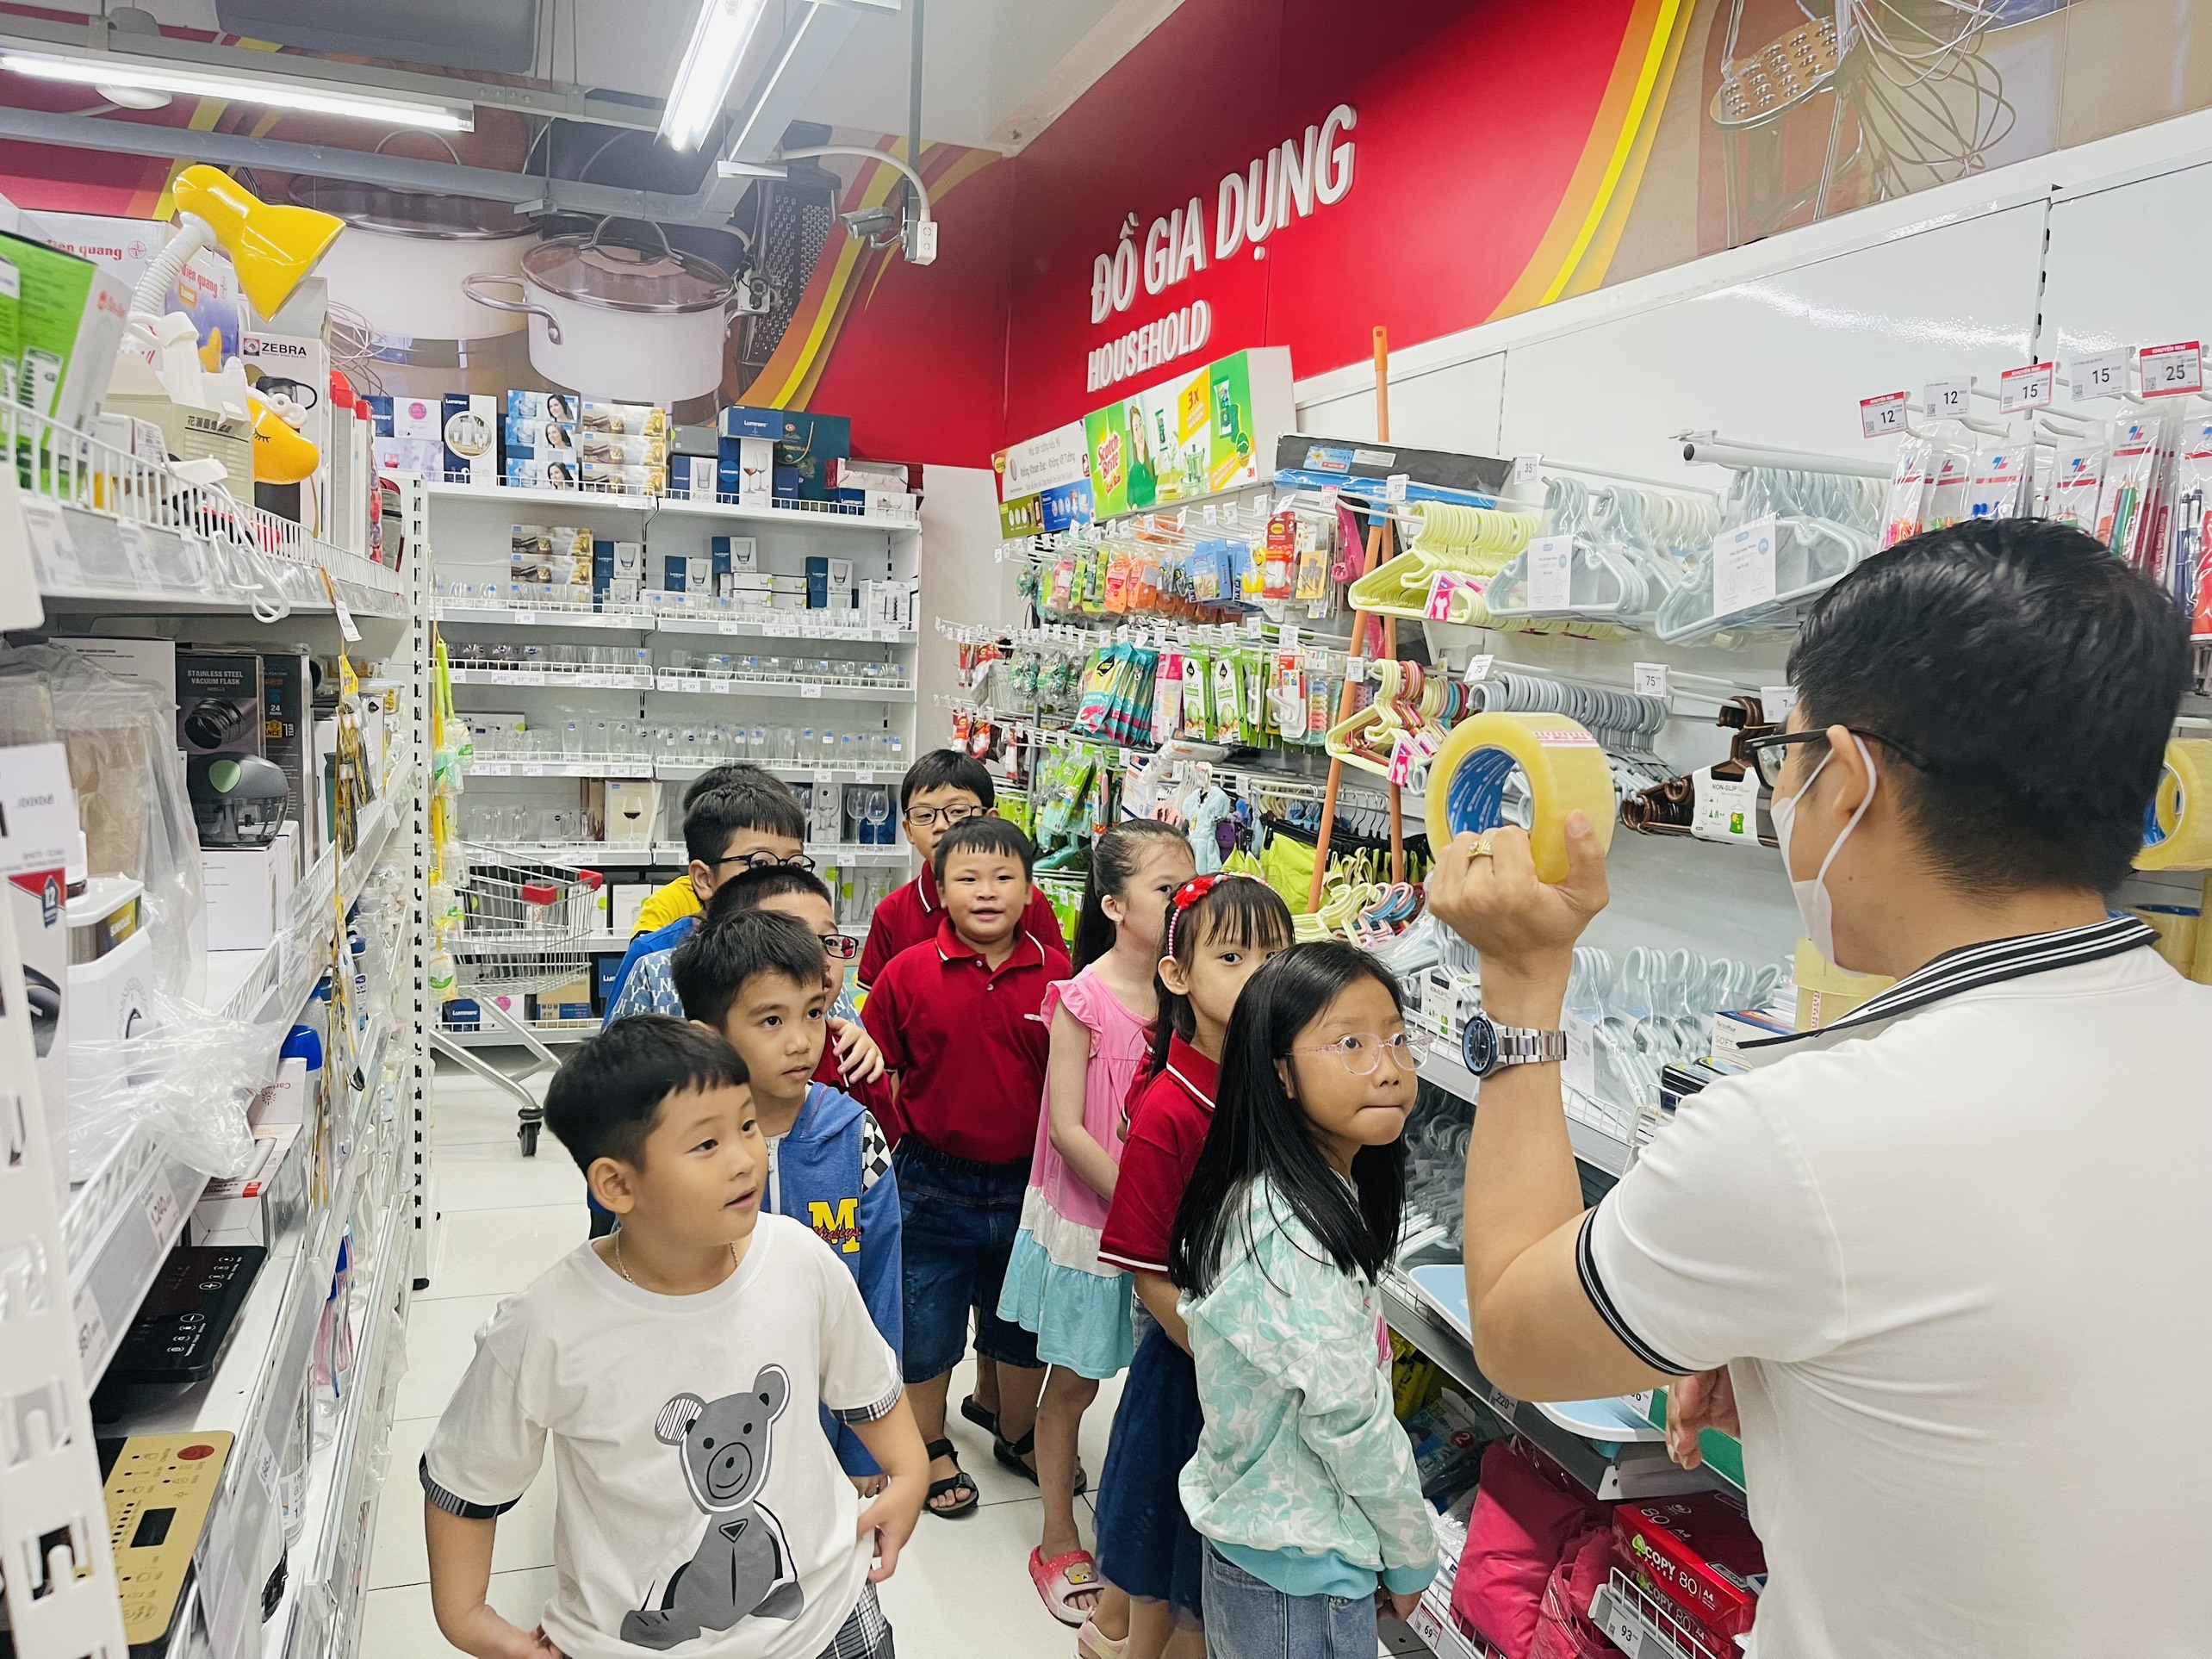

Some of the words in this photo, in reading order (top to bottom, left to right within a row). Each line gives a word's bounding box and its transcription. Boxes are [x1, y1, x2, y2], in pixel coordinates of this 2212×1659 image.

[1090, 212, 1139, 324] ĐỒ
[1144, 197, 1208, 295] GIA
[1215, 103, 1358, 260] DỤNG
[79, 245, 122, 261] quang
[197, 273, 218, 299] quang
[262, 342, 308, 356] ZEBRA
[1087, 300, 1211, 393] HOUSEHOLD
[2092, 367, 2110, 384] 15
[2165, 364, 2185, 381] 25
[1943, 390, 1959, 405] 12
[2022, 384, 2039, 399] 15
[743, 419, 769, 428] Luminarc
[1880, 410, 1896, 424] 12
[1098, 432, 1122, 465] Scotch
[1102, 450, 1120, 480] Brite
[1246, 467, 1256, 478] 3M
[1525, 463, 1533, 473] 35
[187, 669, 223, 678] STAINLESS
[1475, 664, 1484, 674] 75
[191, 677, 220, 686] VACUUM
[1645, 675, 1656, 687] 75
[270, 704, 281, 712] 24
[283, 723, 288, 737] 1
[1712, 783, 1737, 792] NON-SLIP
[1715, 1035, 1734, 1048] SOFT
[808, 1196, 861, 1255] M
[1494, 1392, 1511, 1410] 220
[1640, 1507, 1671, 1525] 80
[1644, 1544, 1676, 1577] COPY
[1678, 1570, 1699, 1596] 80
[1647, 1581, 1674, 1613] COPY
[1675, 1607, 1692, 1632] 80
[1423, 1624, 1434, 1638] 69
[1619, 1624, 1634, 1642] 93
